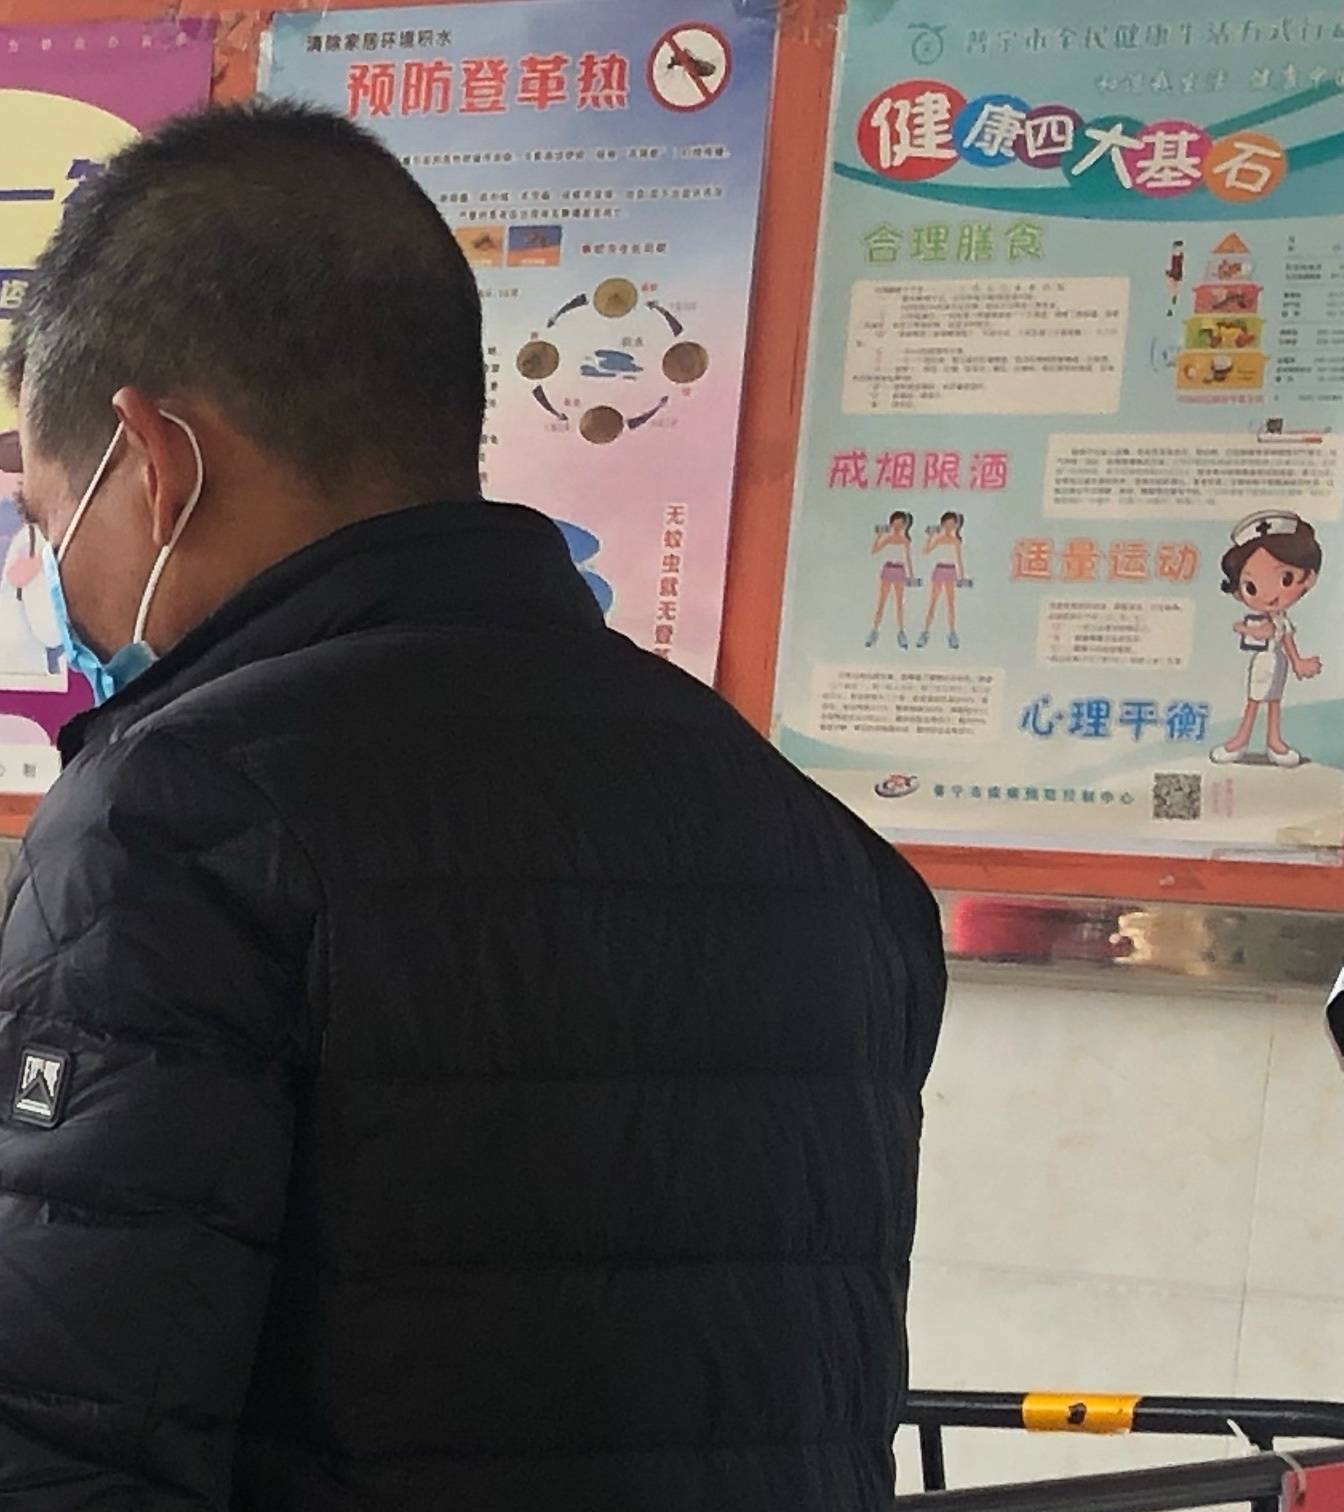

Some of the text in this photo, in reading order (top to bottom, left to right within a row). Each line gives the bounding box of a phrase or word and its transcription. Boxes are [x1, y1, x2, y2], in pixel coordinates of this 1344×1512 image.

[307, 29, 453, 53] 清除家居环境积水
[346, 52, 630, 118] 预防登革热
[869, 90, 1282, 193] 健康四大基石
[863, 219, 1045, 265] 合理膳食
[827, 448, 1010, 490] 戒烟限酒
[655, 504, 687, 664] 无蚊虫就无登
[1011, 537, 1201, 584] 适量运动
[1020, 694, 1212, 742] 心理平衡
